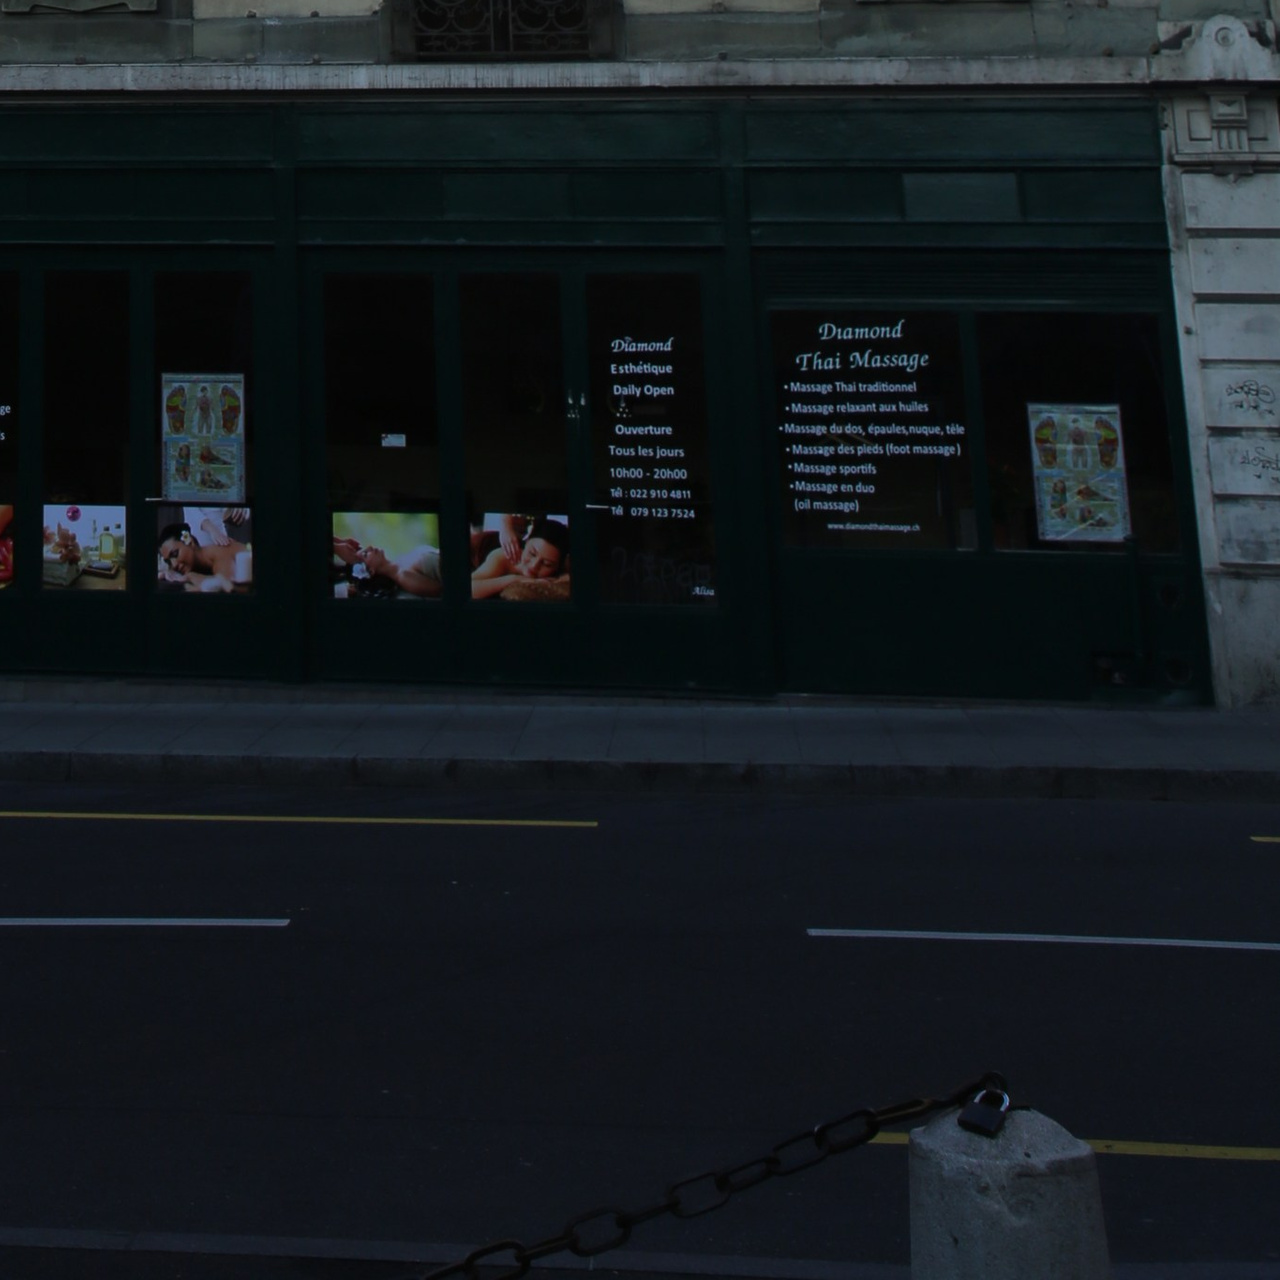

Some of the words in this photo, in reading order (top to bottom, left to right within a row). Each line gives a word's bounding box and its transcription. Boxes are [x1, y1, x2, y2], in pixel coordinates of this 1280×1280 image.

[819, 318, 905, 341] Diamond
[610, 336, 675, 353] Diamond
[795, 351, 842, 371] Thai
[849, 348, 930, 373] Massage
[610, 360, 673, 376] Esthétique
[613, 384, 641, 398] Daily
[643, 384, 675, 398] Open
[790, 382, 833, 395] Massage
[834, 381, 857, 392] Thai
[858, 381, 917, 392] traditionnel
[791, 403, 835, 415] Massage
[836, 402, 877, 413] relaxant
[878, 403, 897, 413] aux
[898, 401, 929, 412] huiles
[615, 424, 673, 435] Ouverture
[784, 423, 827, 436] Massage
[829, 423, 843, 434] du
[844, 423, 866, 436] dos,
[608, 444, 636, 456] Tous
[637, 445, 654, 456] les
[655, 445, 685, 459] jours
[792, 444, 835, 457] Massage
[837, 444, 855, 454] des
[856, 444, 884, 456] pieds
[885, 443, 910, 456] (foot
[609, 468, 644, 479] 10h00
[653, 468, 688, 479] 20h00
[794, 462, 837, 476] Massage
[839, 463, 877, 475] sportifs
[629, 488, 648, 499] 022
[649, 488, 668, 499] 910
[669, 489, 691, 499] 4811
[795, 480, 838, 494] Massage
[840, 483, 853, 492] en
[855, 482, 875, 493] duo
[630, 507, 649, 517] 079
[651, 507, 668, 517] 123
[670, 508, 695, 518] 7524
[794, 498, 811, 512] (oil
[813, 499, 859, 513] massage)
